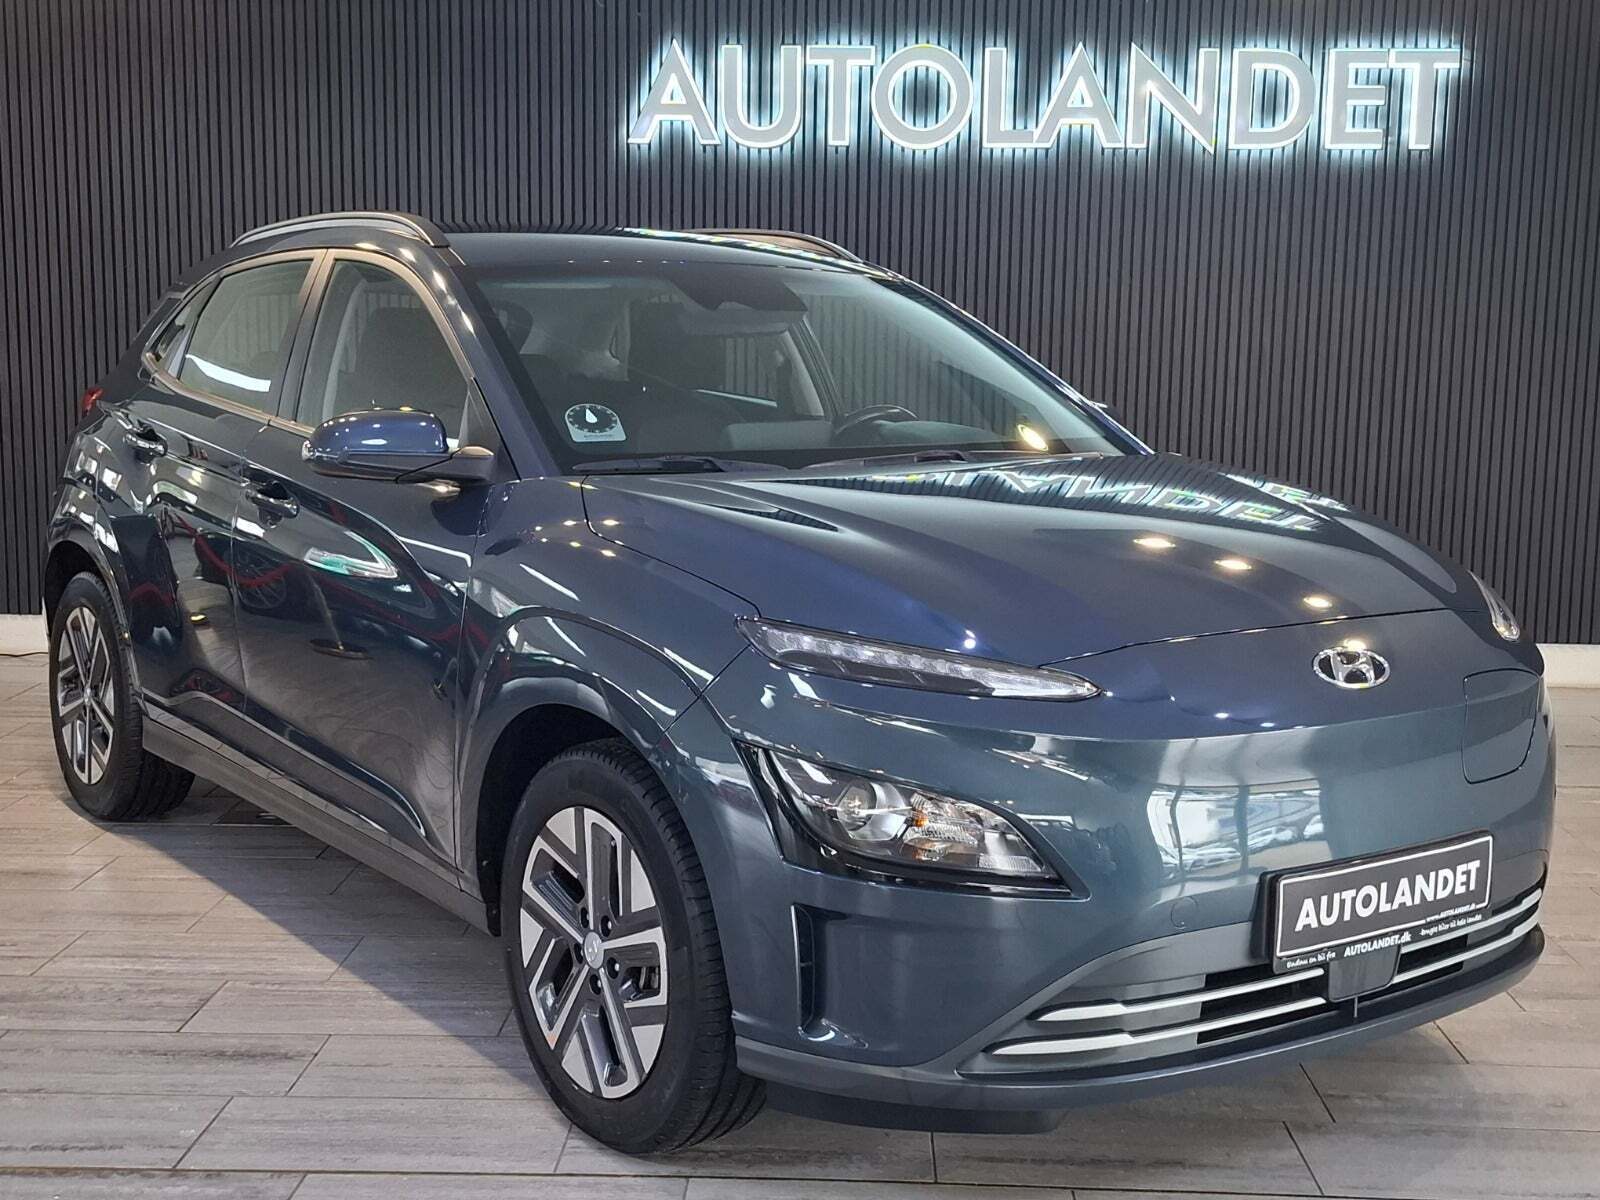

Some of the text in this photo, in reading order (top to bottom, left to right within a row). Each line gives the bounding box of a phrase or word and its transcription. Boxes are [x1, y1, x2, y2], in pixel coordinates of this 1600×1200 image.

[628, 38, 1464, 156] AUTOLANDET
[1295, 860, 1480, 931] AUTOLANDET
[1344, 931, 1411, 957] AUTOLANDET.dk
